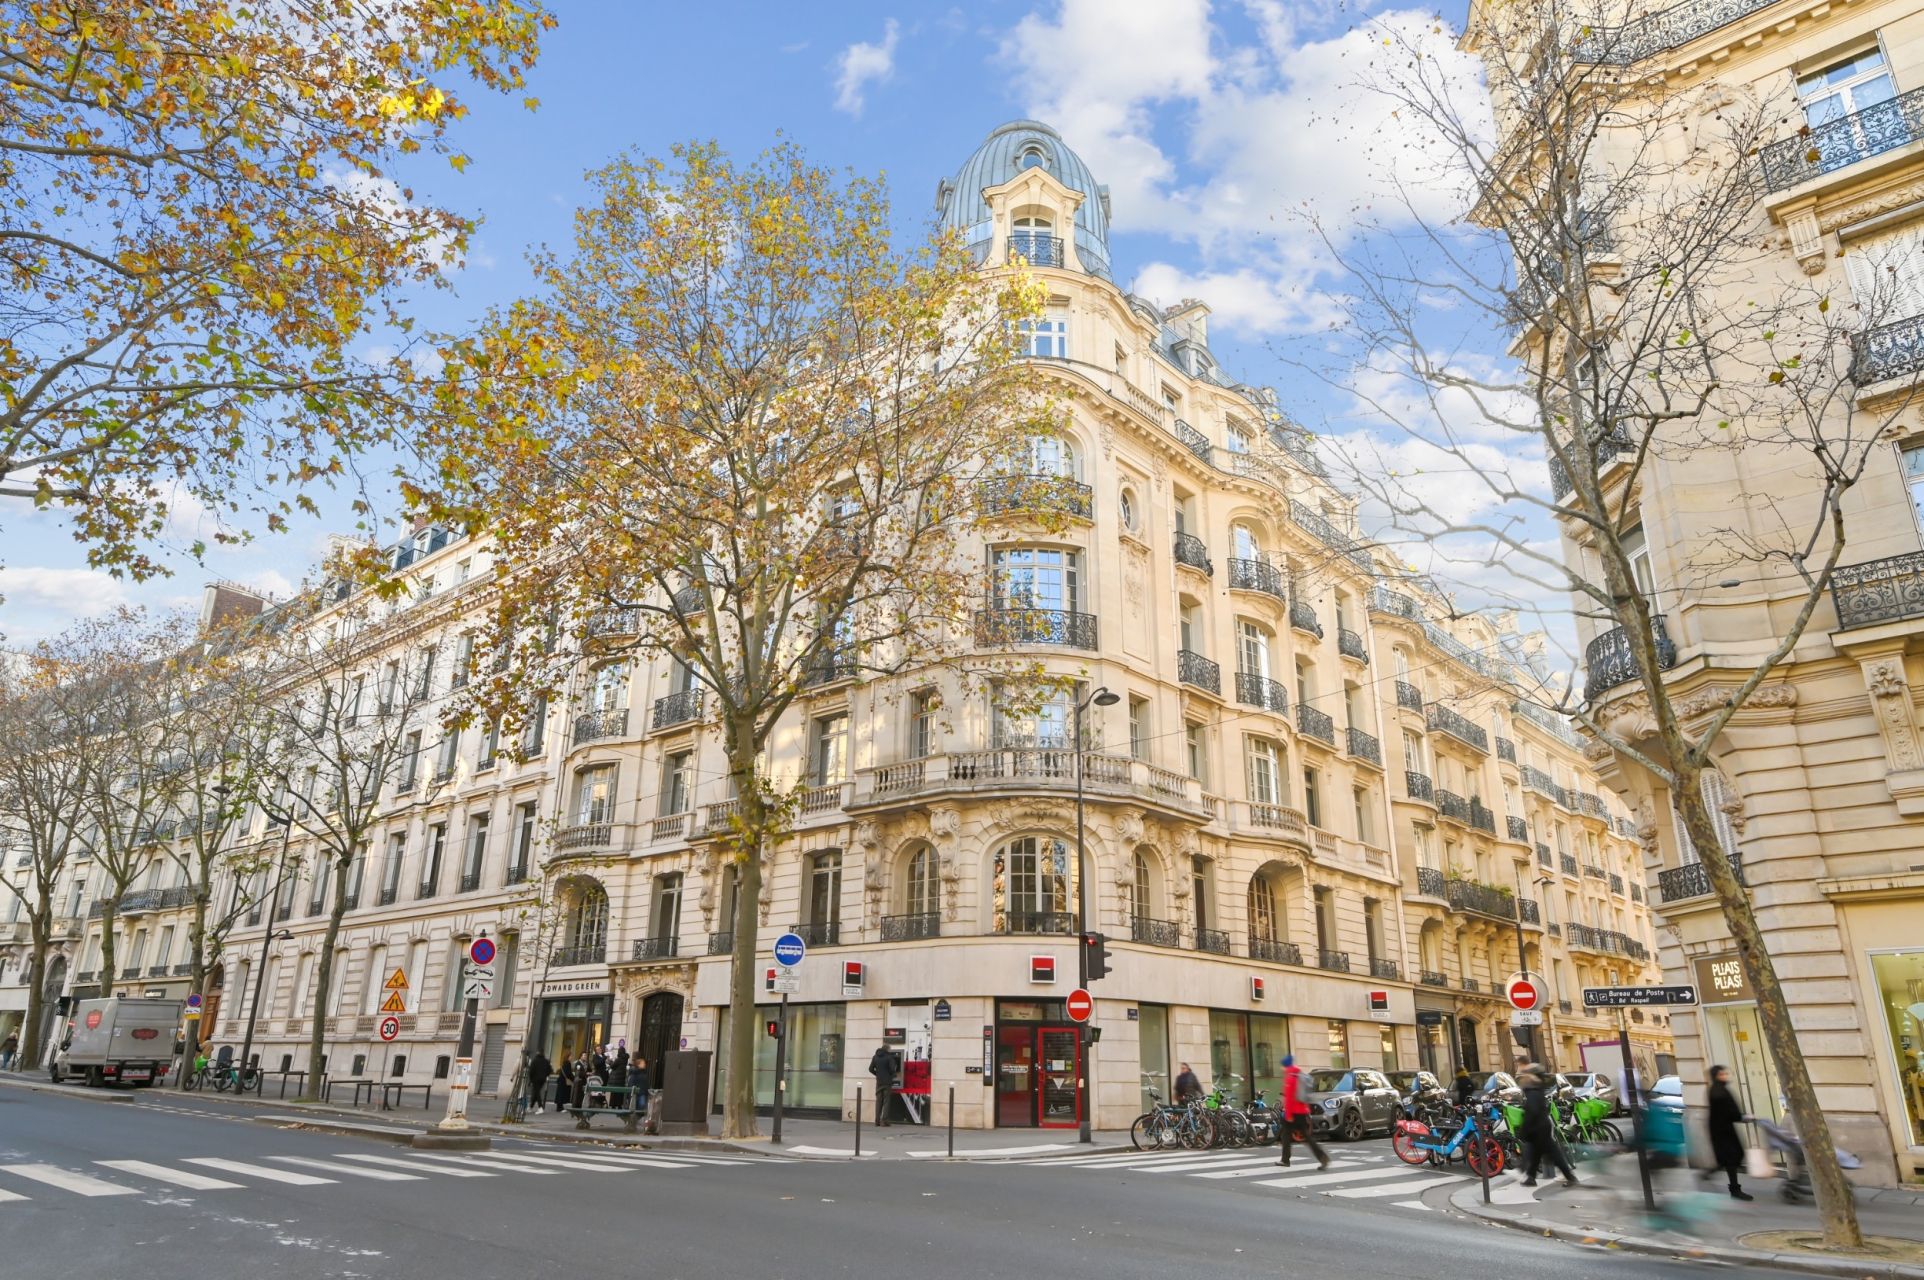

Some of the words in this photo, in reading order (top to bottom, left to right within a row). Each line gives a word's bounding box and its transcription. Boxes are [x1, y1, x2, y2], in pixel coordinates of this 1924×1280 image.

[542, 984, 573, 992] EDWARD
[575, 982, 601, 990] GREEN
[384, 1023, 396, 1034] 30
